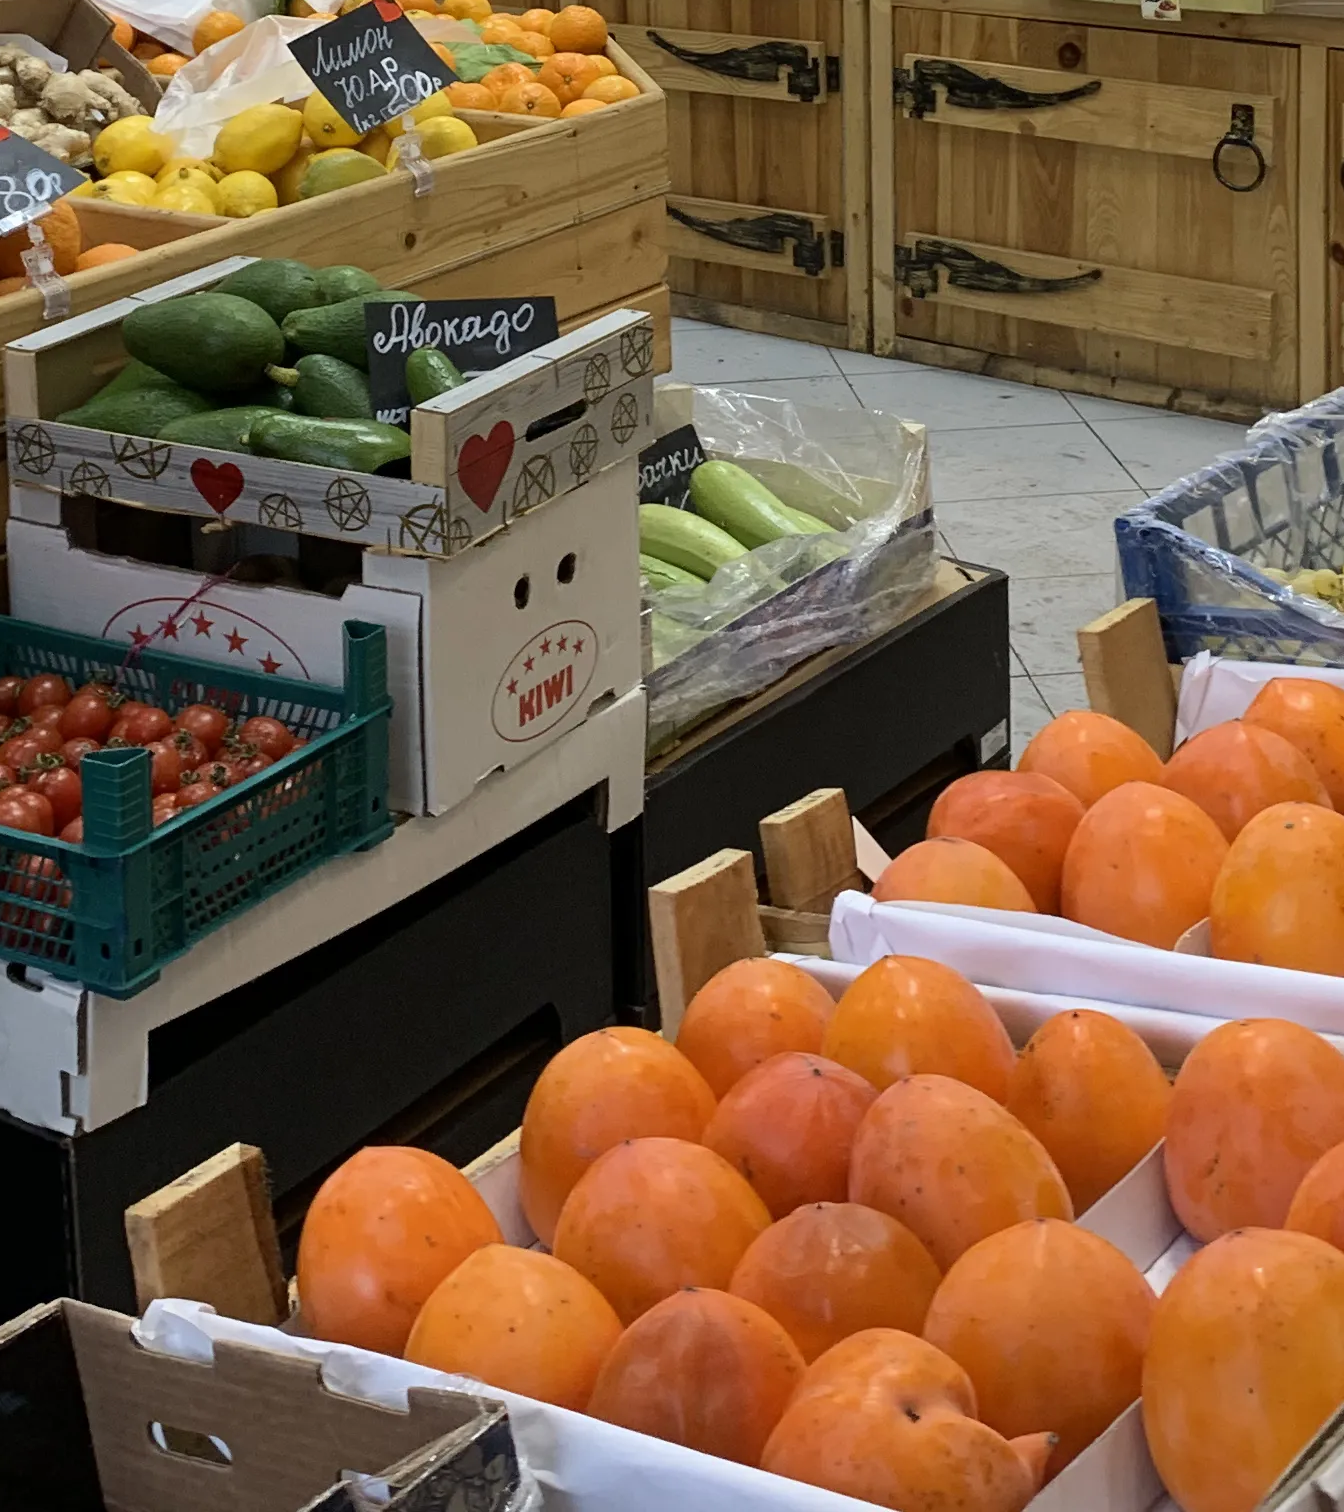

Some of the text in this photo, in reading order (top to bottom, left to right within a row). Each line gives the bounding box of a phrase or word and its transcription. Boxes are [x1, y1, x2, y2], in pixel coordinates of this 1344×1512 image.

[312, 25, 394, 77] Лимон
[372, 302, 536, 355] Авокадо
[518, 664, 574, 728] KIWI
